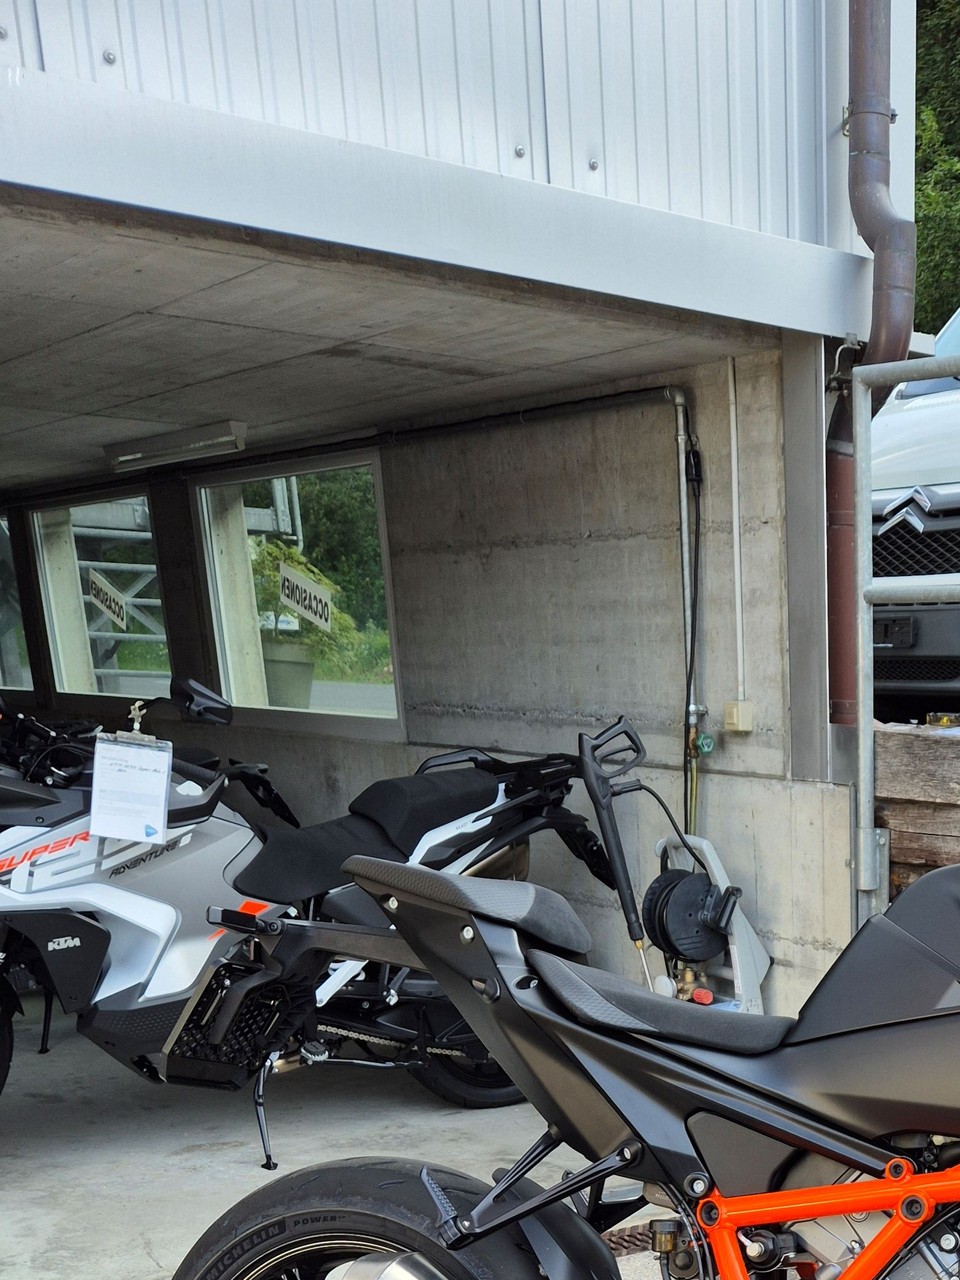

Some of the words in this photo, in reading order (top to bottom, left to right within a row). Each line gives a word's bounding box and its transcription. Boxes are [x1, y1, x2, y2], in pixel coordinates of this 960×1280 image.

[0, 830, 90, 873] SUPER
[108, 840, 178, 879] ADVENTURE
[48, 936, 81, 951] KTM
[293, 1215, 337, 1228] POWER
